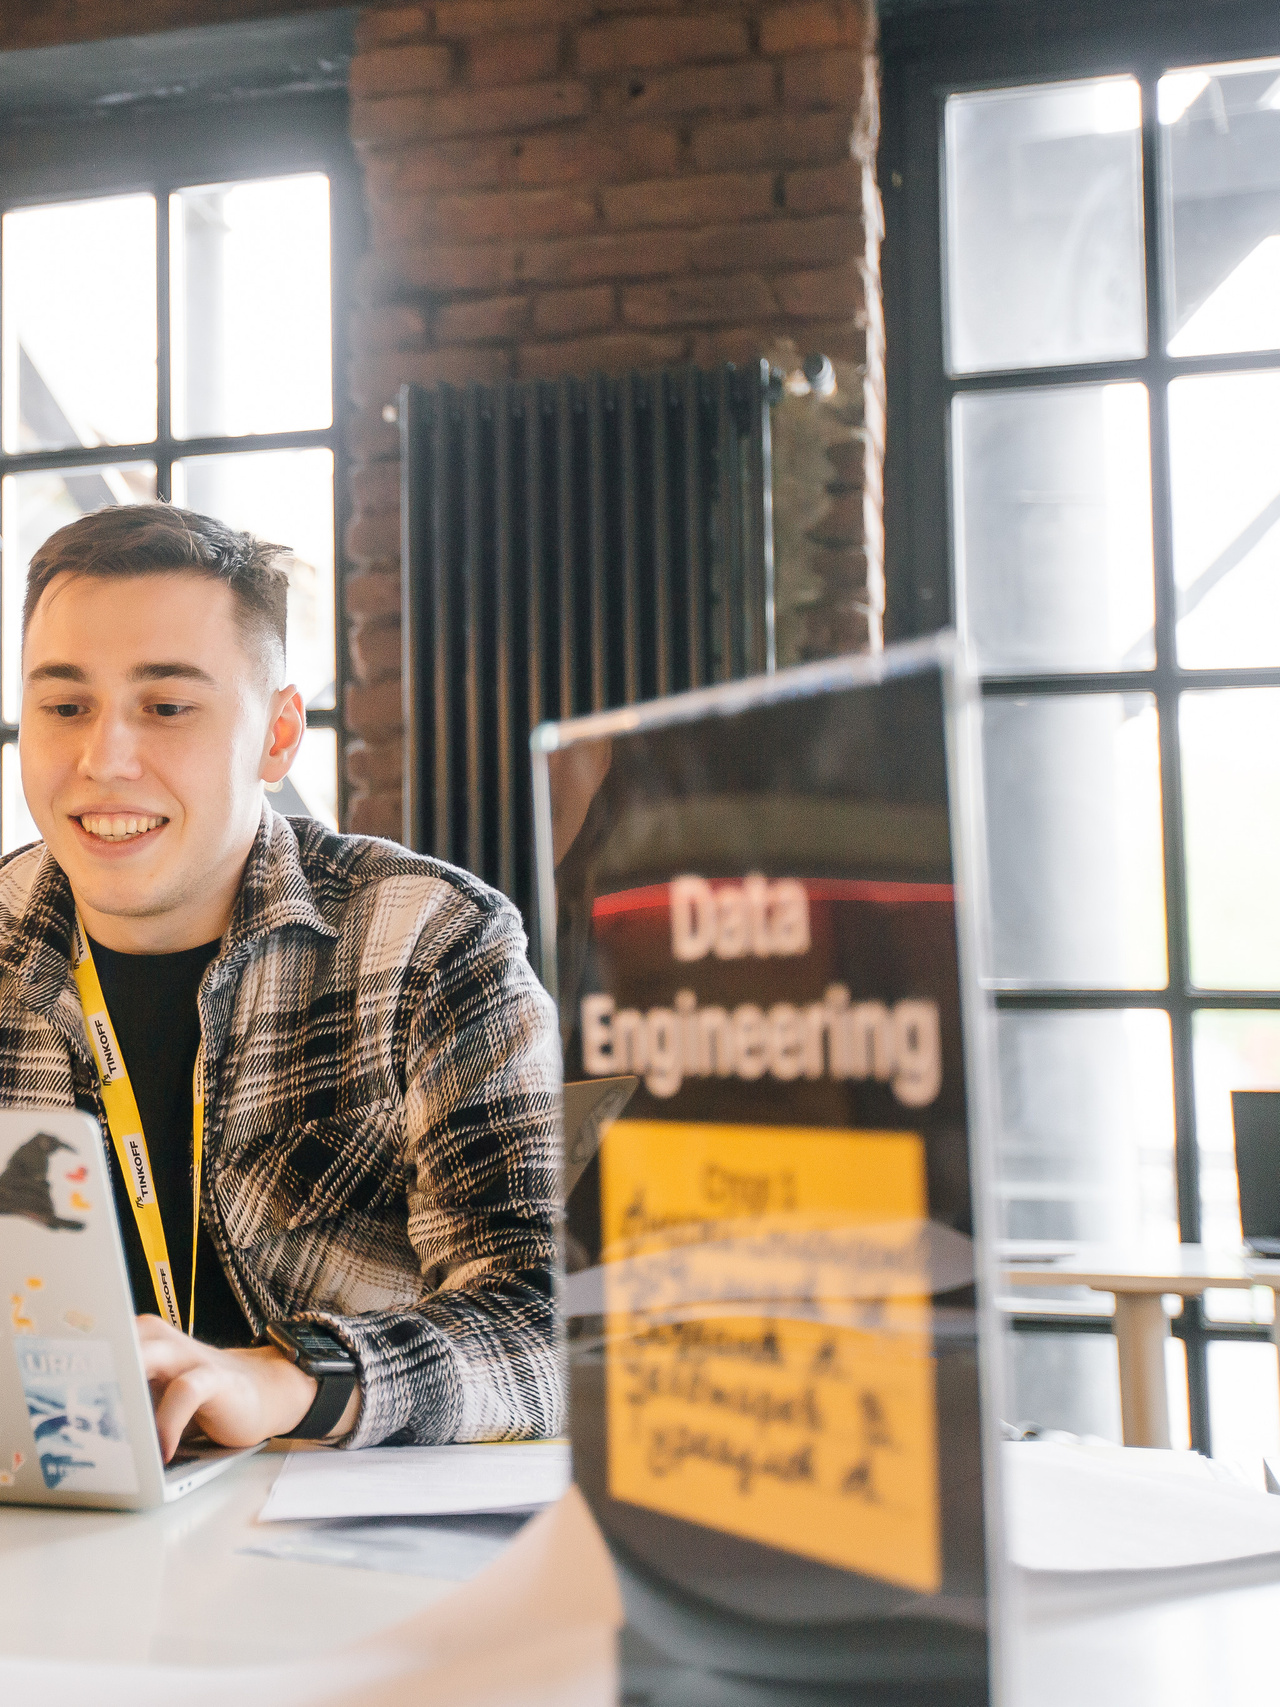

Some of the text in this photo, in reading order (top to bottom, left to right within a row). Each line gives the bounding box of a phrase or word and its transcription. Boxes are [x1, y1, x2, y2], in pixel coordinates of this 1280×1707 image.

[670, 874, 812, 962] Data
[94, 1019, 117, 1075] TINKOFF
[581, 981, 943, 1108] Engineering
[129, 1140, 149, 1198] TINKOFF
[160, 1268, 178, 1327] TINKOFF
